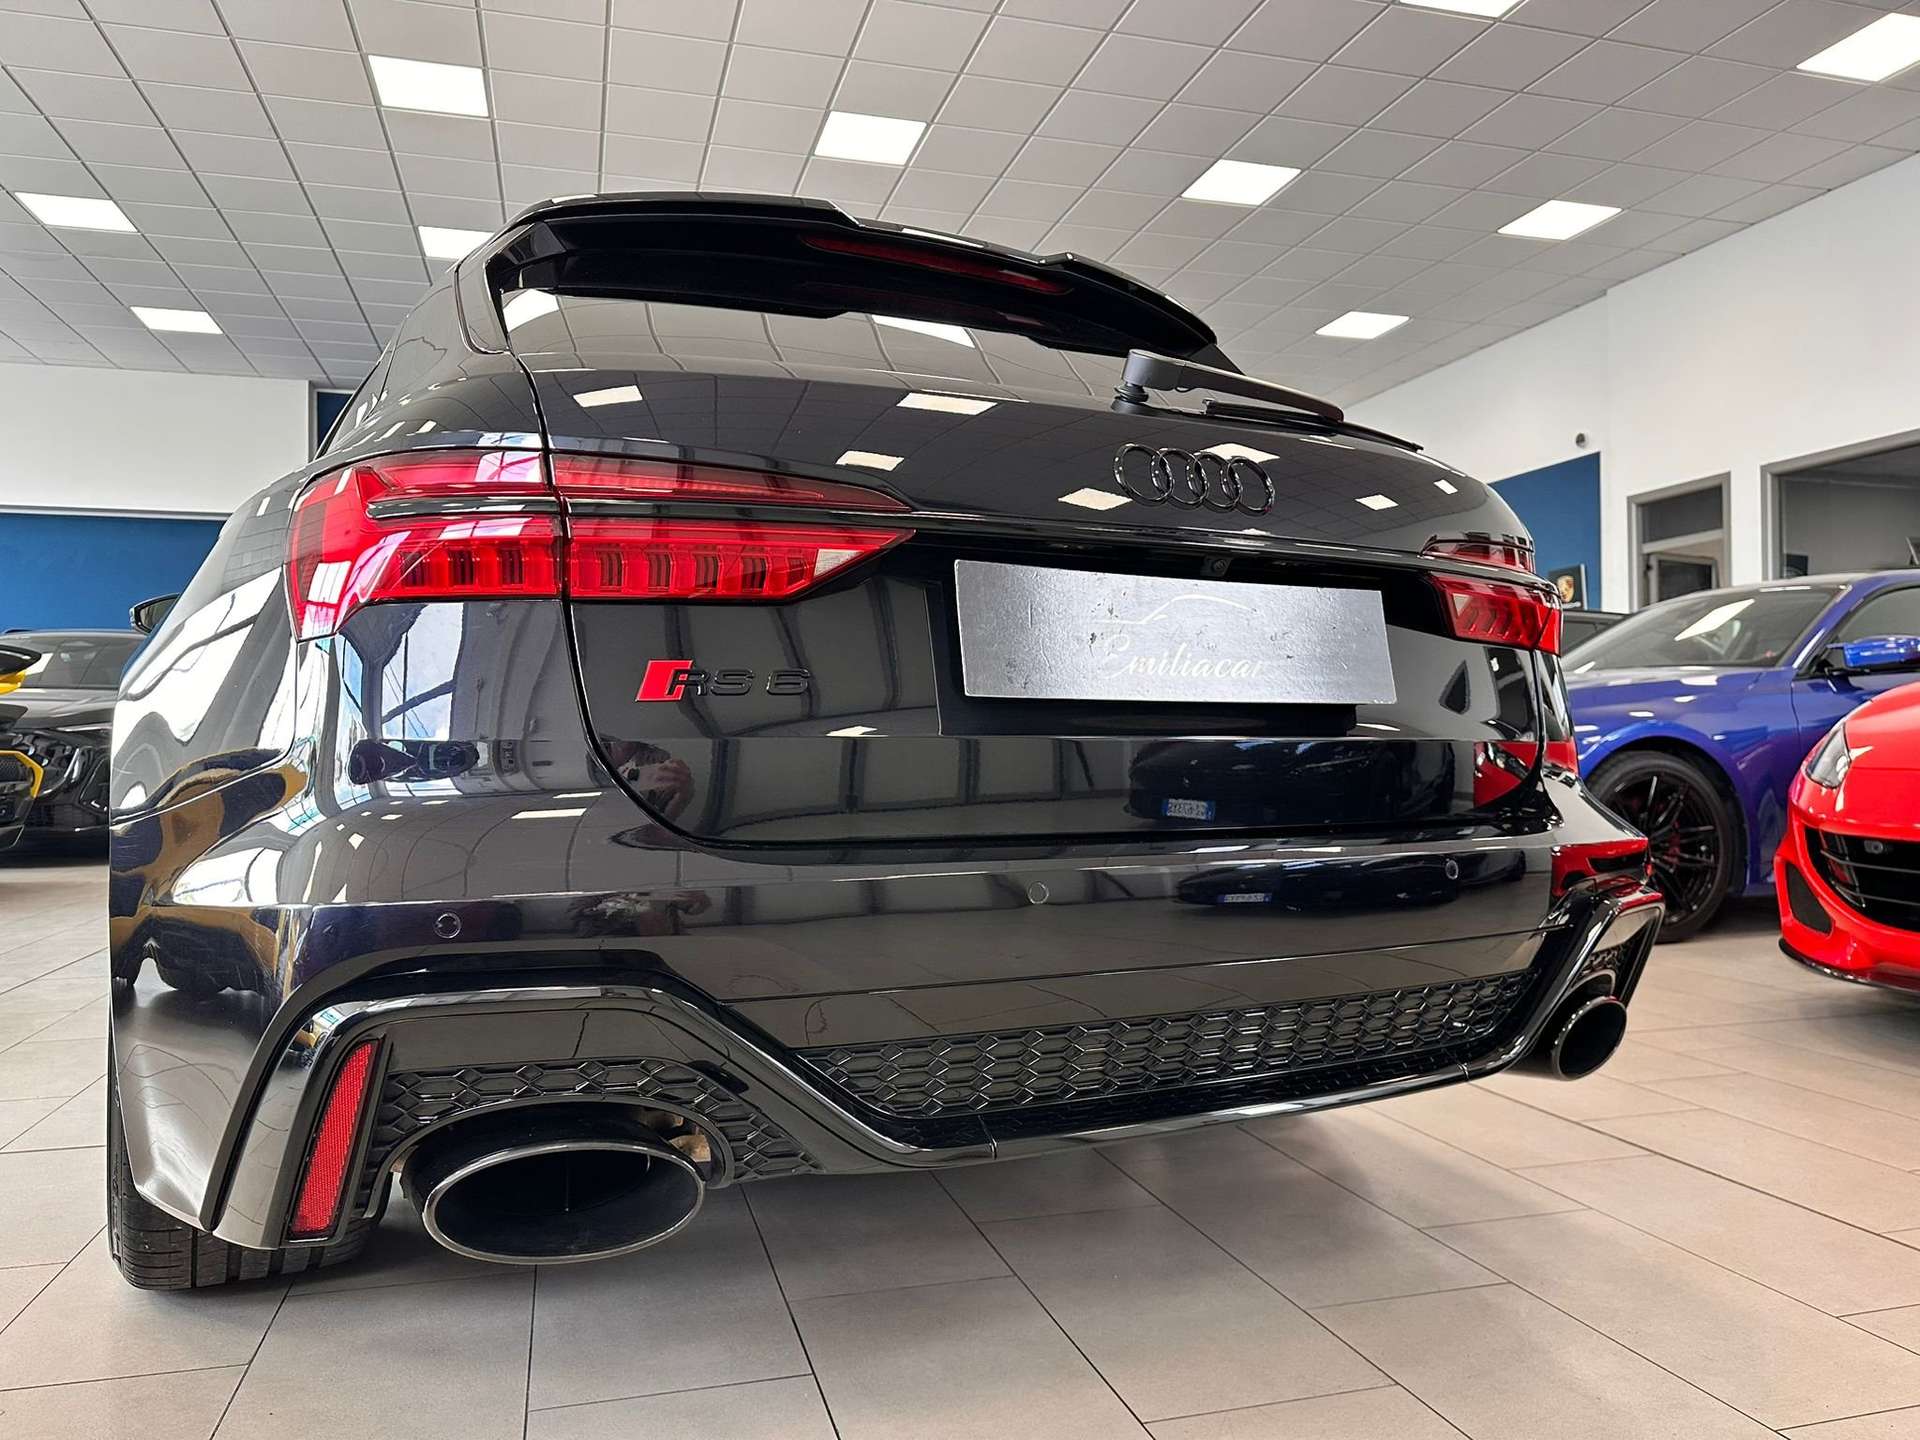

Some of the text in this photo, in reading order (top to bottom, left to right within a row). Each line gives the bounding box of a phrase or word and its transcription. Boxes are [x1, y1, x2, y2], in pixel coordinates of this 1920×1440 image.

[1102, 633, 1266, 680] Emiliacar
[660, 667, 811, 697] RS 6
